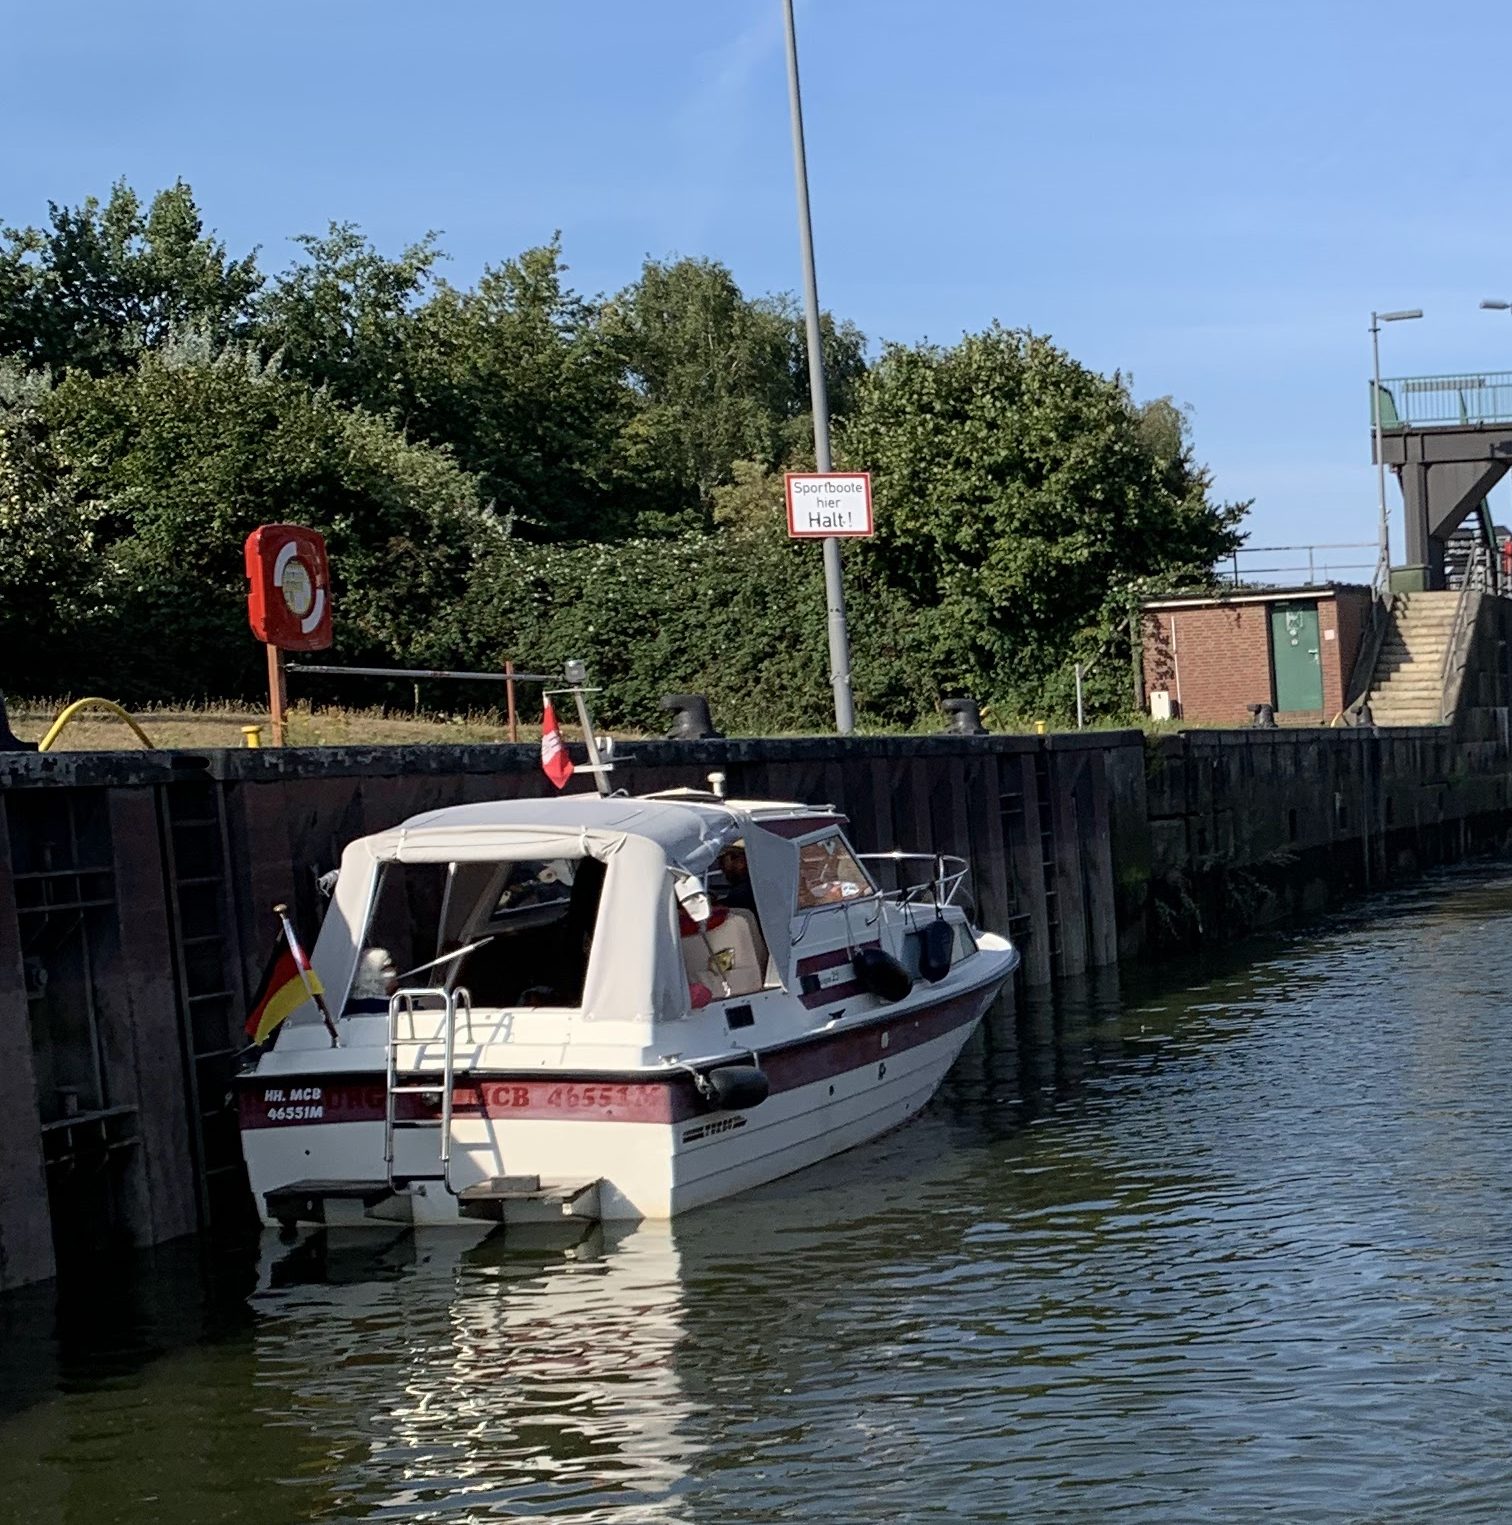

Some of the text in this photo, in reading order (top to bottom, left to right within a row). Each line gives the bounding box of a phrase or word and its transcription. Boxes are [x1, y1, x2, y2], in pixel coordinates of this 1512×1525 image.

[793, 481, 863, 496] Sportboote
[816, 497, 841, 508] hier
[264, 1089, 286, 1102] HH.
[289, 1087, 322, 1101] MCB
[267, 1105, 324, 1121] 46551M
